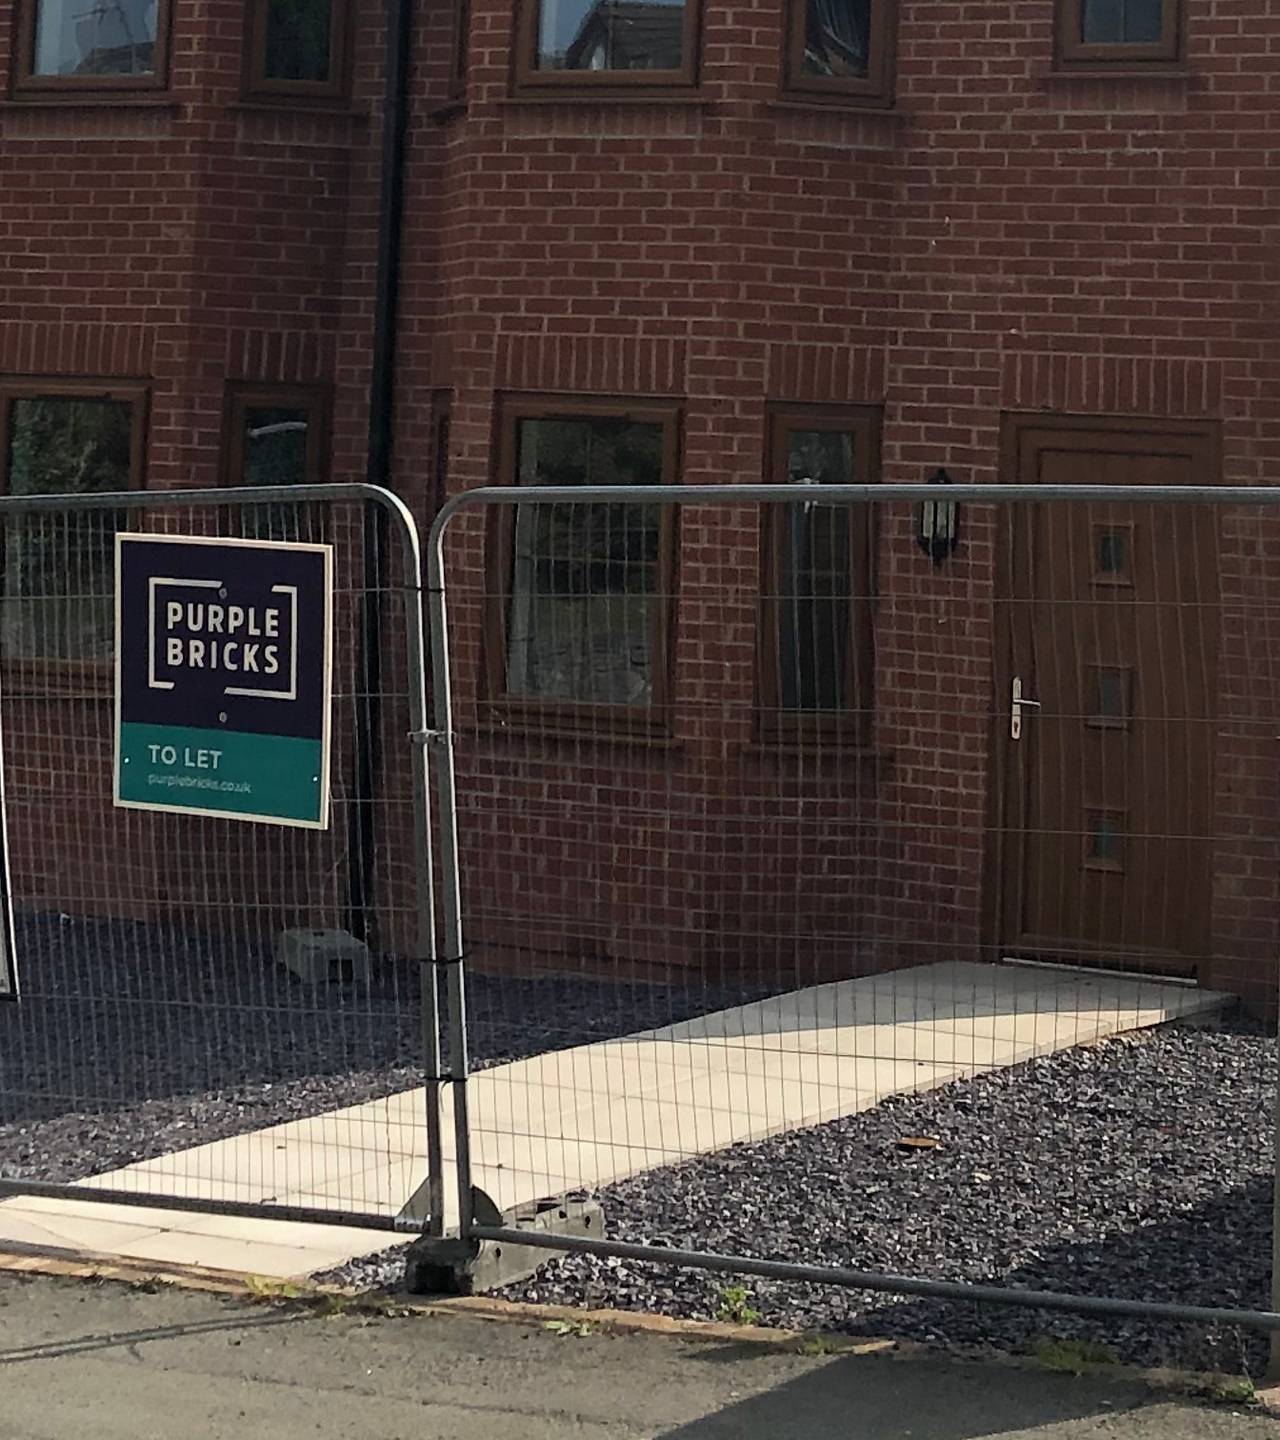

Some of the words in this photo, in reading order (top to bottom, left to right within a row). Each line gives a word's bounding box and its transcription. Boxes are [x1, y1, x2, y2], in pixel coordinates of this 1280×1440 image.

[167, 601, 279, 637] PURPLE
[167, 637, 279, 674] BRICKS
[148, 744, 177, 765] TO
[184, 747, 223, 769] LET
